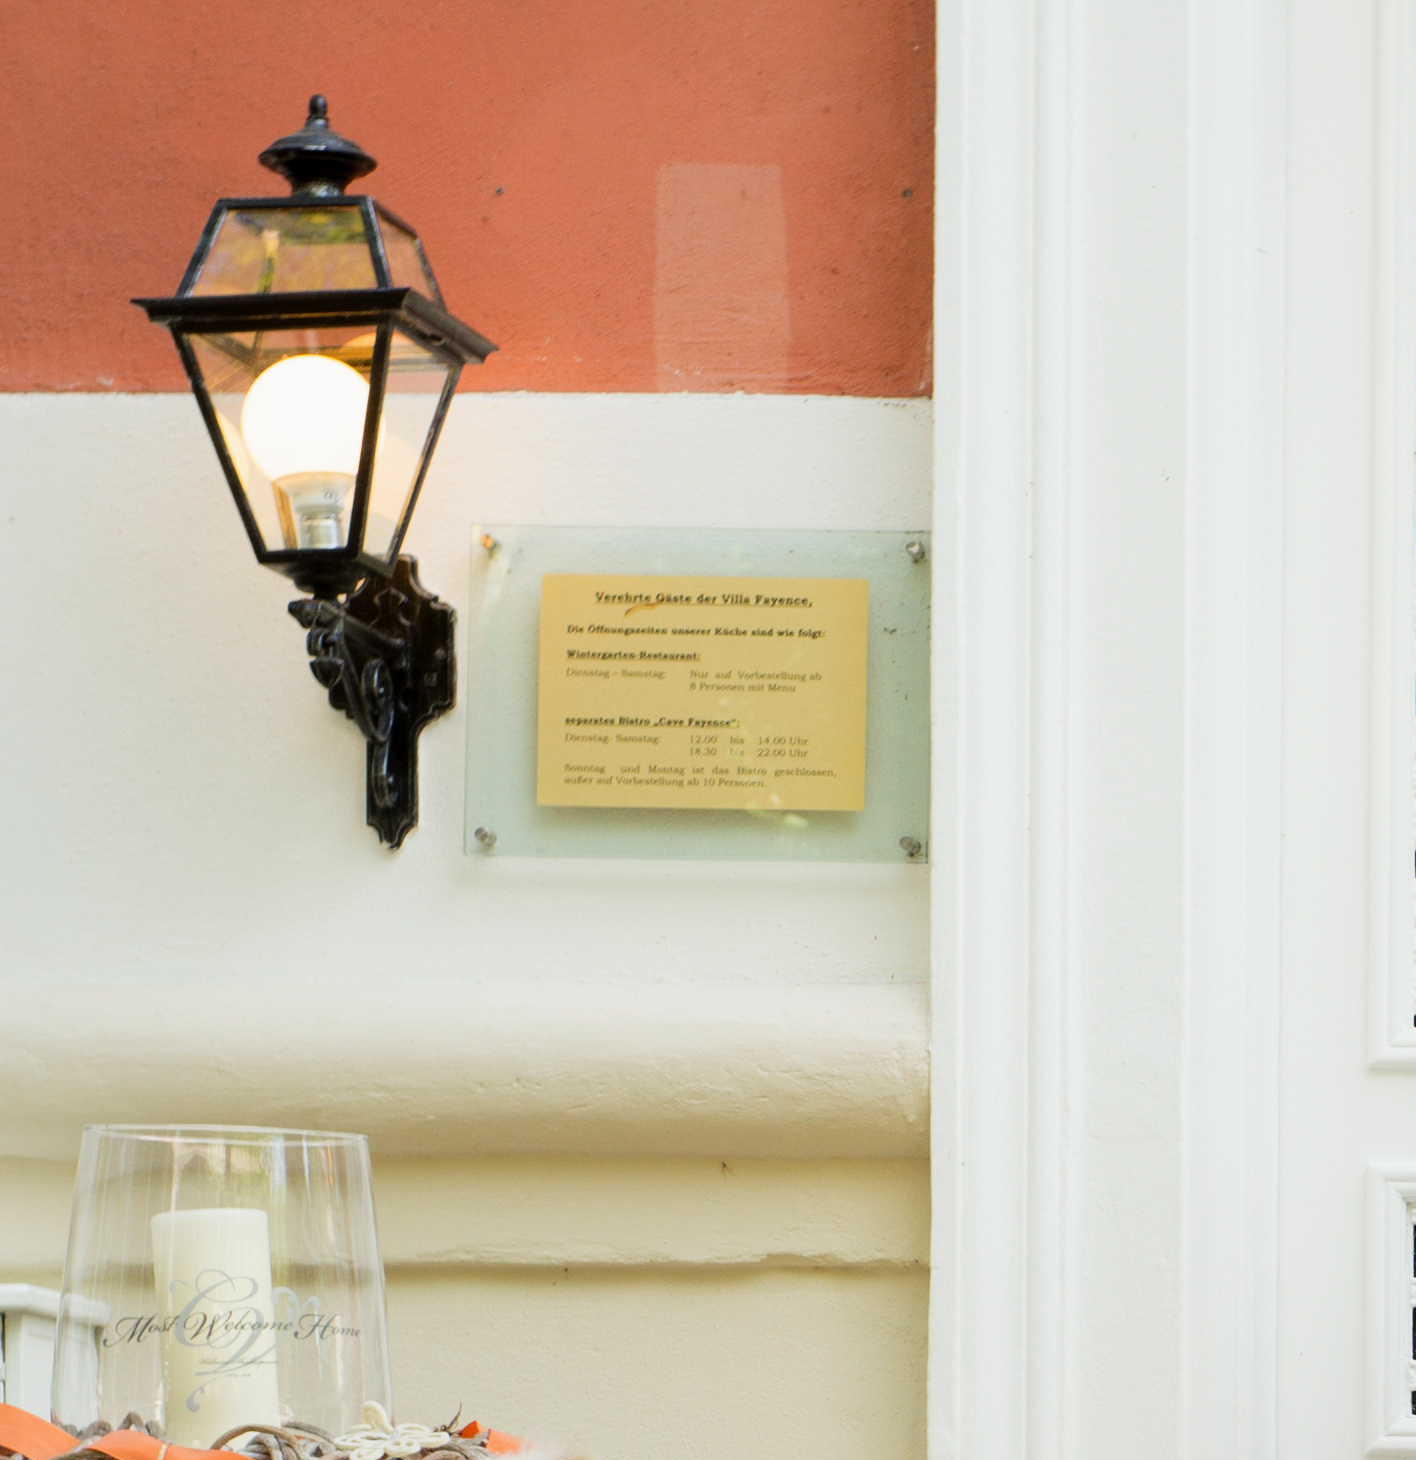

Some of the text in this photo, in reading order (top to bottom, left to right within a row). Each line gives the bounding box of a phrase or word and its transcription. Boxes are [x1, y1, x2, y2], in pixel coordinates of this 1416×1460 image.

[596, 591, 813, 607] Verehrte Gäste der Villa Fayence,
[567, 624, 826, 639] Die Öffnungszeiten unserer Küche sind wie folgt:
[566, 668, 610, 679] Dienstag
[690, 670, 709, 679] Nur
[715, 670, 732, 679] auf
[738, 670, 806, 682] Vorbestellung
[809, 672, 822, 680] ab
[700, 683, 745, 692] Personen
[748, 683, 764, 692] mit
[768, 684, 796, 692] Menu
[565, 716, 615, 726] separates
[618, 716, 650, 725] Bistro
[690, 735, 717, 744] 12.00
[730, 736, 745, 745] bis
[758, 736, 786, 745] 14.00
[789, 737, 809, 745] Uhr
[690, 747, 808, 758] 18.30 bis 22.00 Uhr
[564, 764, 838, 777] Sonntag und Montag ist das Bistro geschlossen,
[564, 775, 593, 784] außer
[596, 776, 614, 785] auf
[616, 776, 684, 787] Vorbestellung
[687, 778, 699, 786] ab
[703, 778, 715, 786] 10
[103, 1310, 362, 1347] Most Welcome Home
